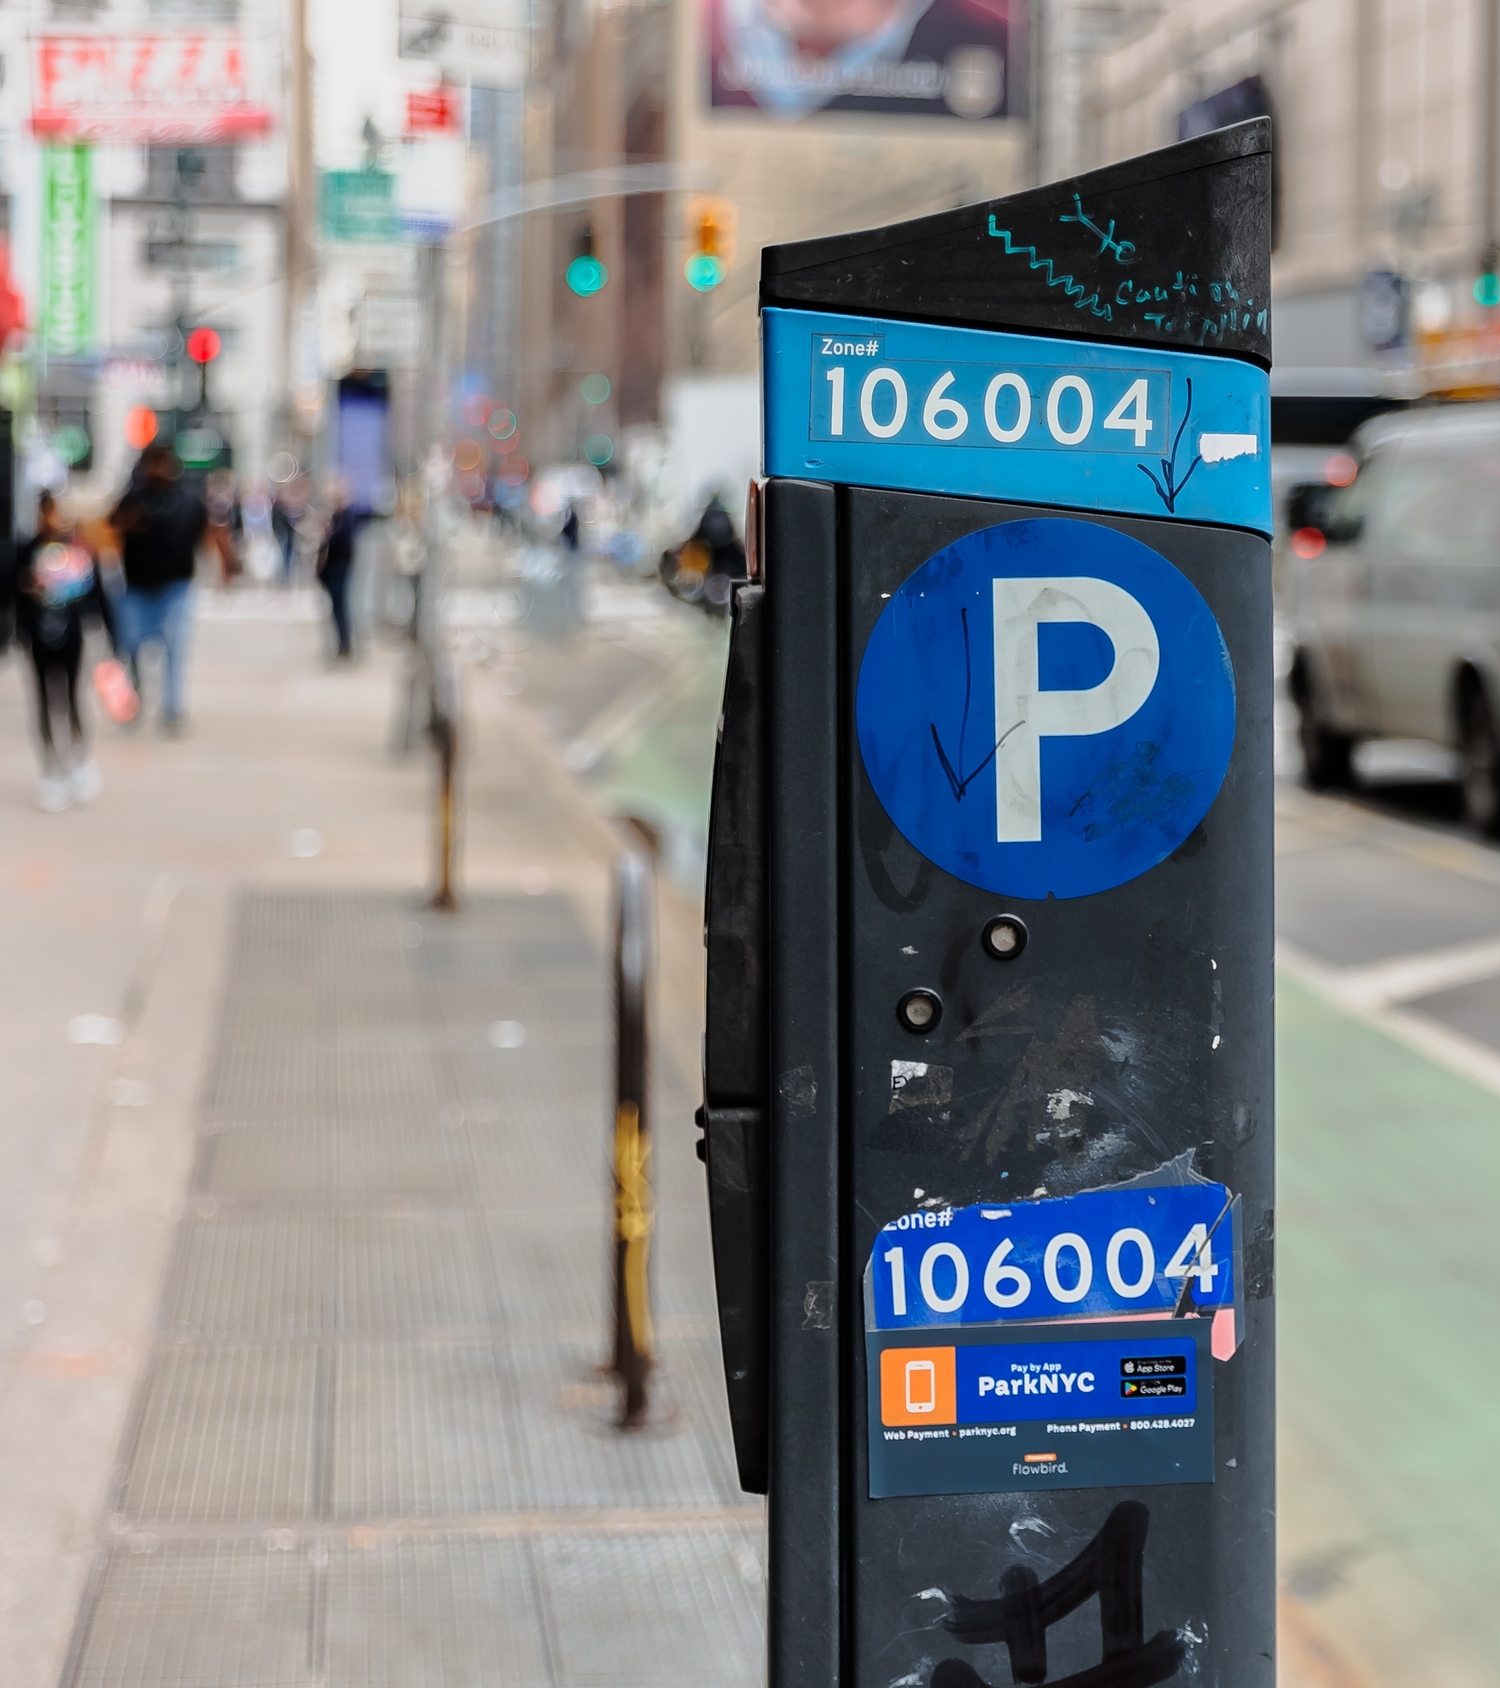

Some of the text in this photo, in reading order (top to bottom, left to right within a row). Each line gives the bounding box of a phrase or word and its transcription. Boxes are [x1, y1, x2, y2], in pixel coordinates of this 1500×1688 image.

[822, 338, 879, 357] Zone#
[826, 366, 1153, 447] 106004
[992, 576, 1160, 842] P
[884, 1223, 1219, 1316] 106004
[1011, 1362, 1062, 1374] Pay by App
[1137, 1363, 1175, 1374] App Store
[978, 1371, 1095, 1397] ParkNYC
[1140, 1383, 1183, 1396] Google Play
[884, 1425, 1017, 1442] Web Payment parknyc.org
[1047, 1418, 1196, 1434] Phone Payment 800.428.4027
